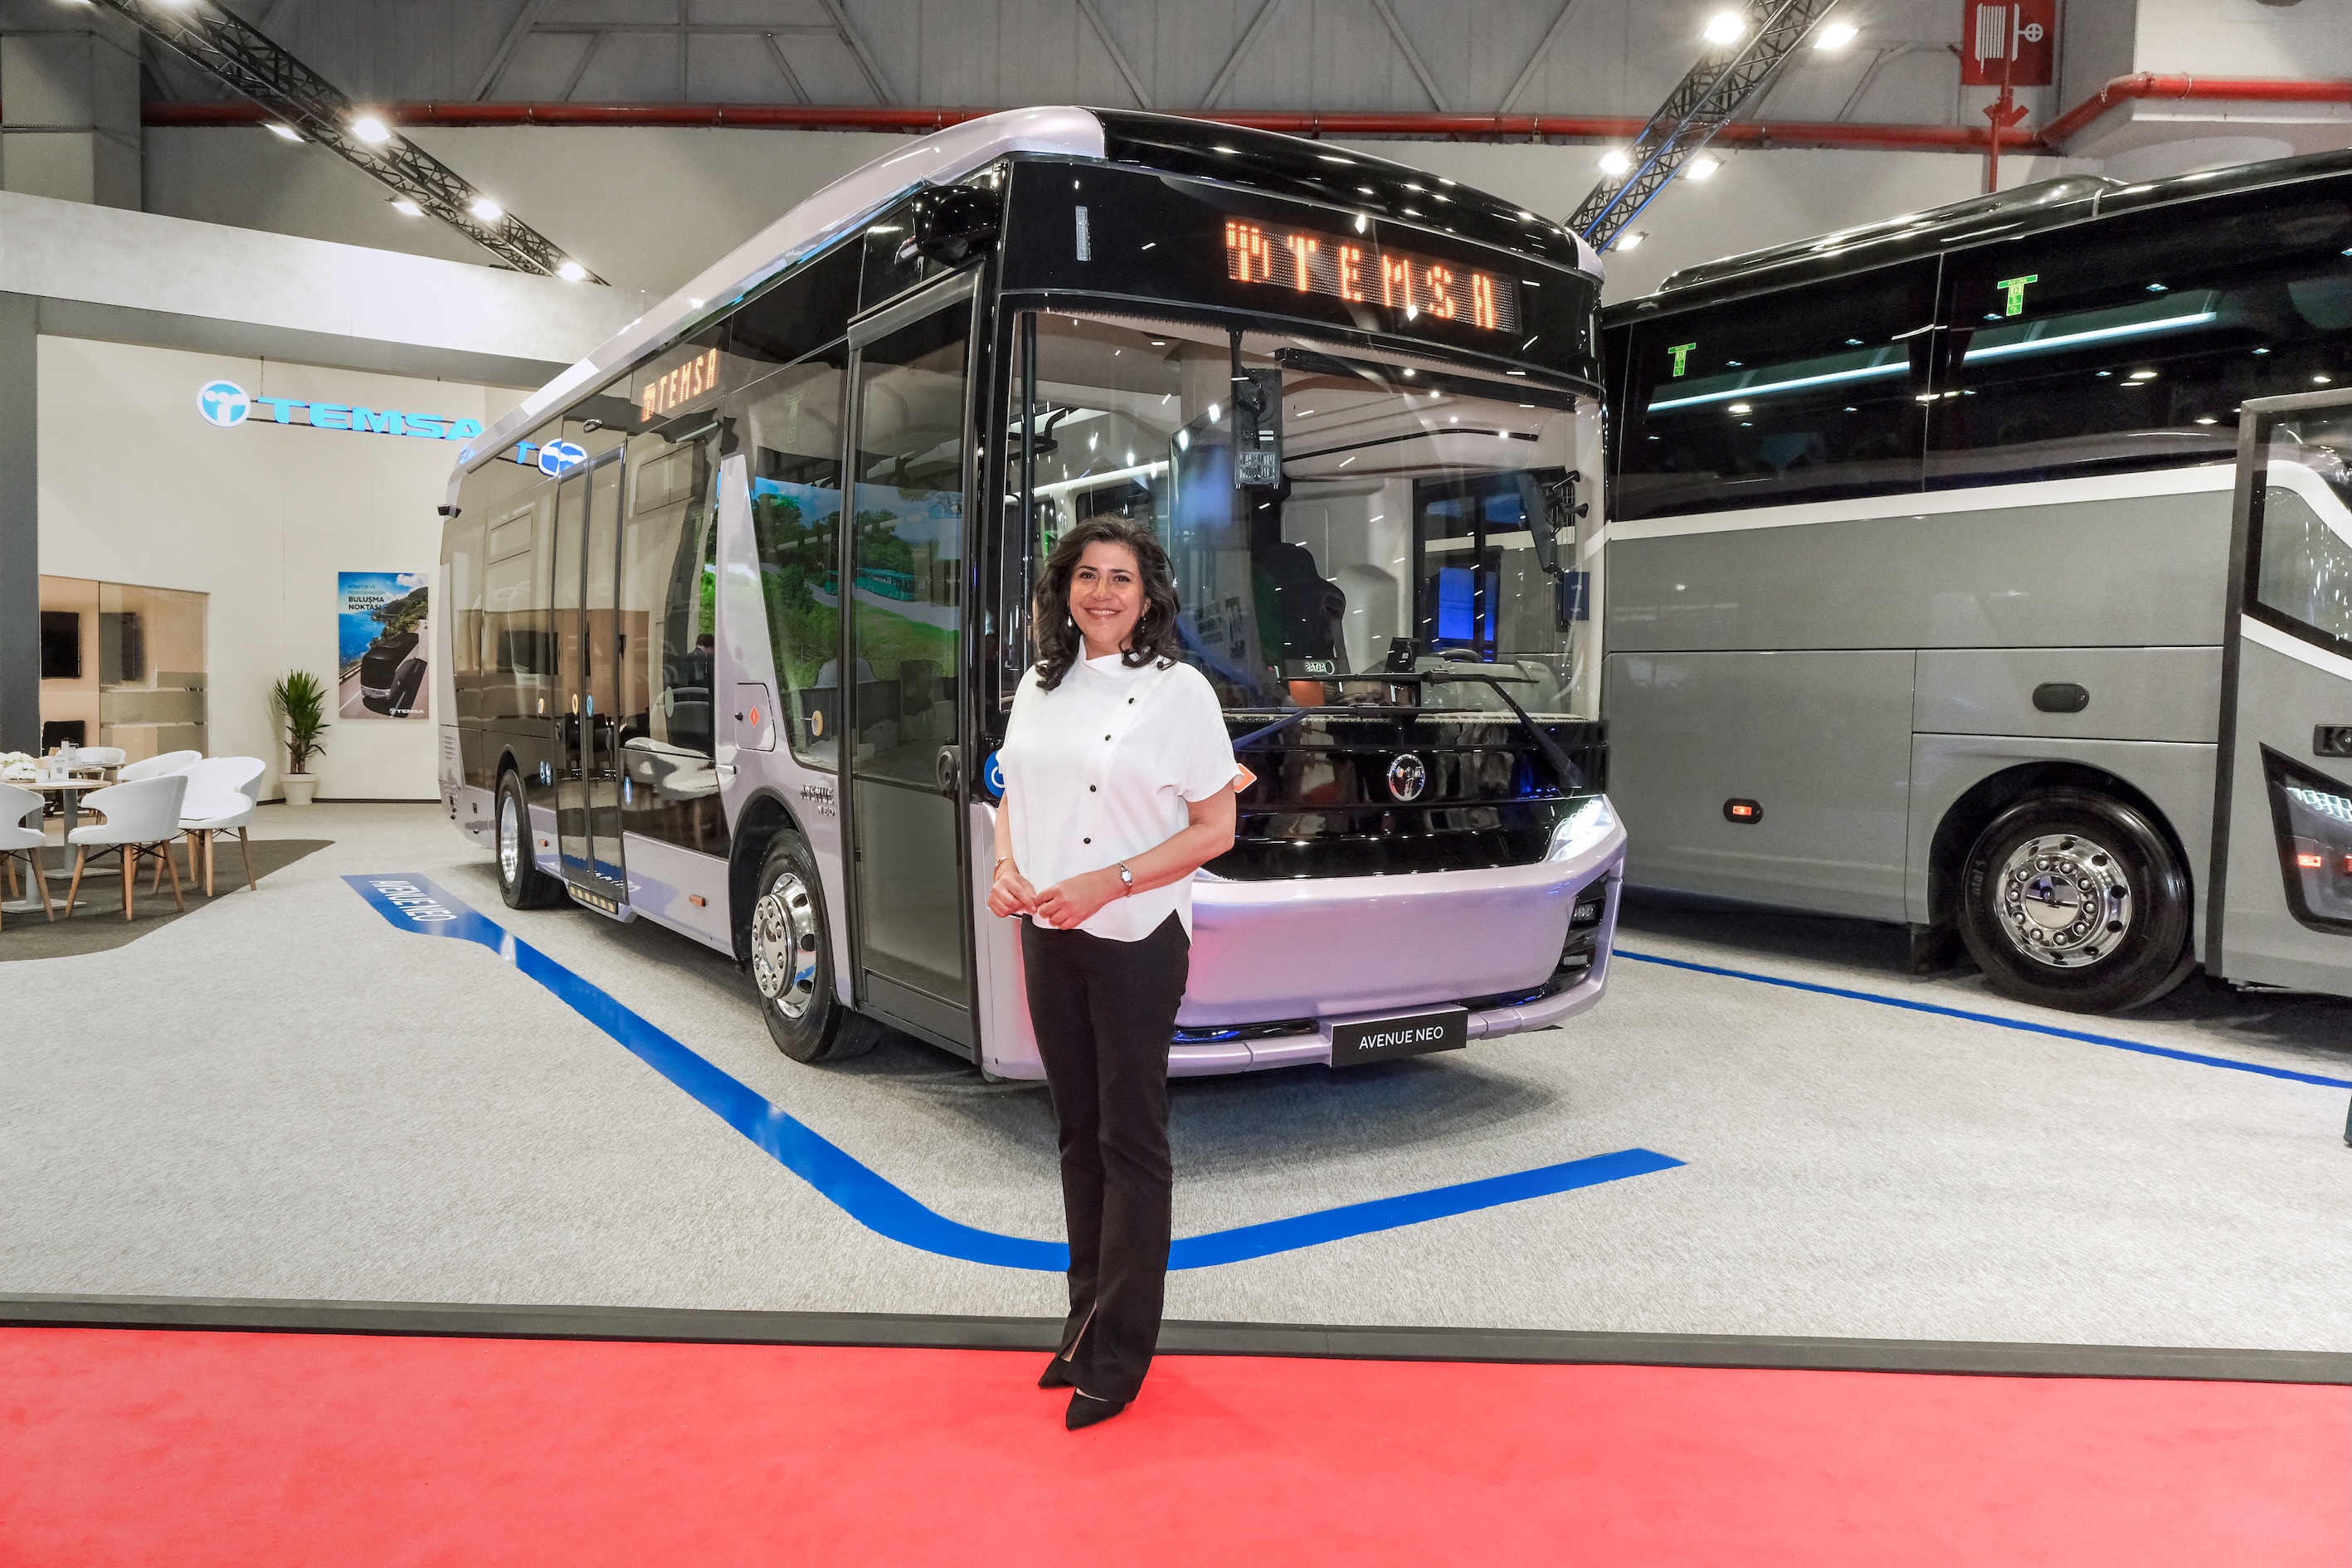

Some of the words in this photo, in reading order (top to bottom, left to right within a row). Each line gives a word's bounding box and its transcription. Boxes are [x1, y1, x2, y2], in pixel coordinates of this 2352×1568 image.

[1288, 234, 1496, 329] TEMSA
[658, 347, 717, 413] TEMSA
[257, 396, 485, 441] TEMSA
[348, 596, 384, 604] BULUŞMA
[801, 784, 835, 805] AVENUE
[818, 806, 836, 816] NEO
[368, 880, 437, 906] AVENUE
[399, 903, 458, 922] NEO
[1358, 1030, 1413, 1050] AVENUE
[1415, 1025, 1444, 1042] NEO
